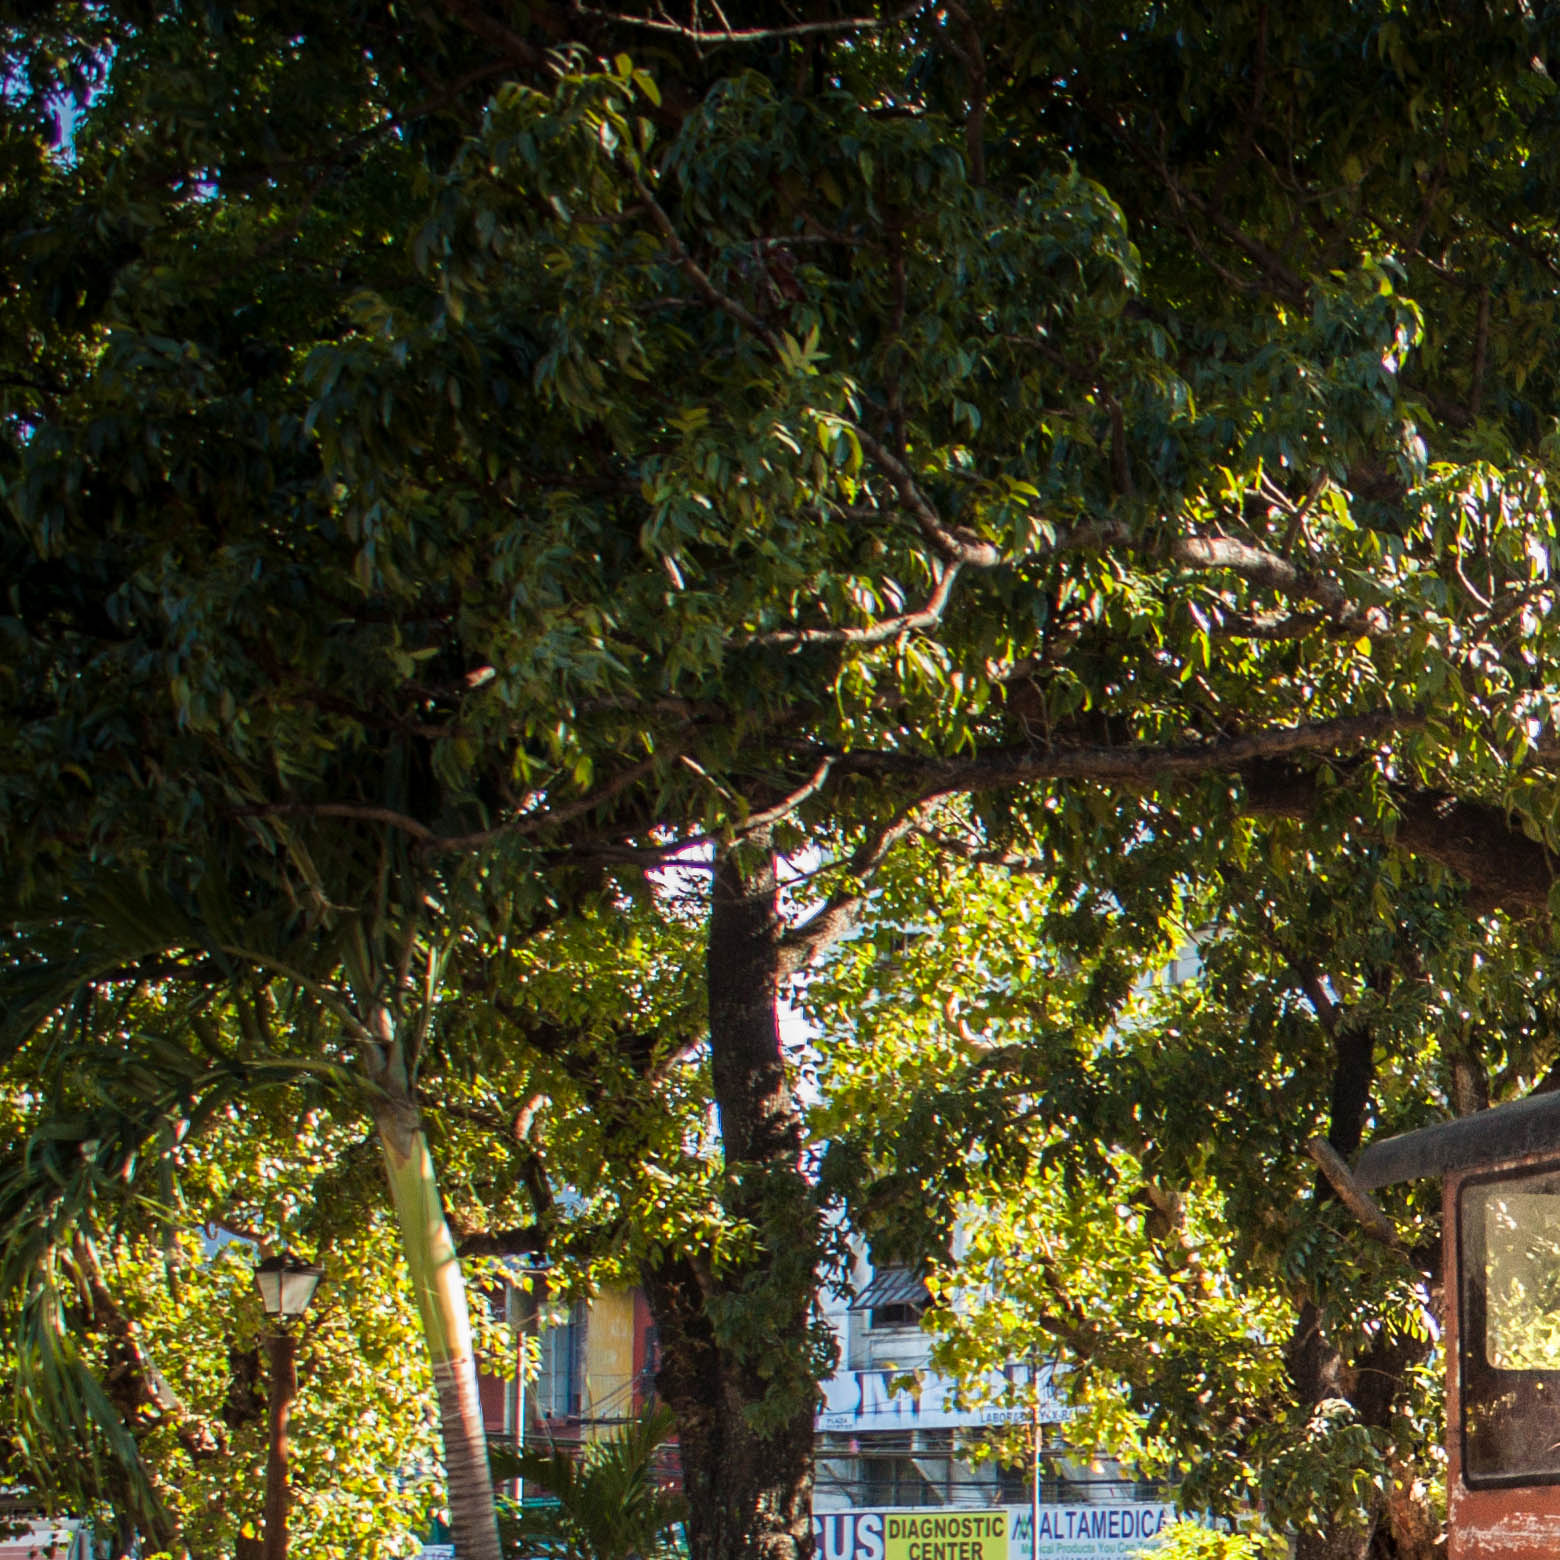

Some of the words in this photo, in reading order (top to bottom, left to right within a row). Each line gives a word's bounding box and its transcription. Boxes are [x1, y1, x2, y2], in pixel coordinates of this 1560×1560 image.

[888, 1516, 1005, 1540] DIAGNOSTIC
[1056, 1542, 1097, 1554] Products
[1099, 1542, 1118, 1554] You
